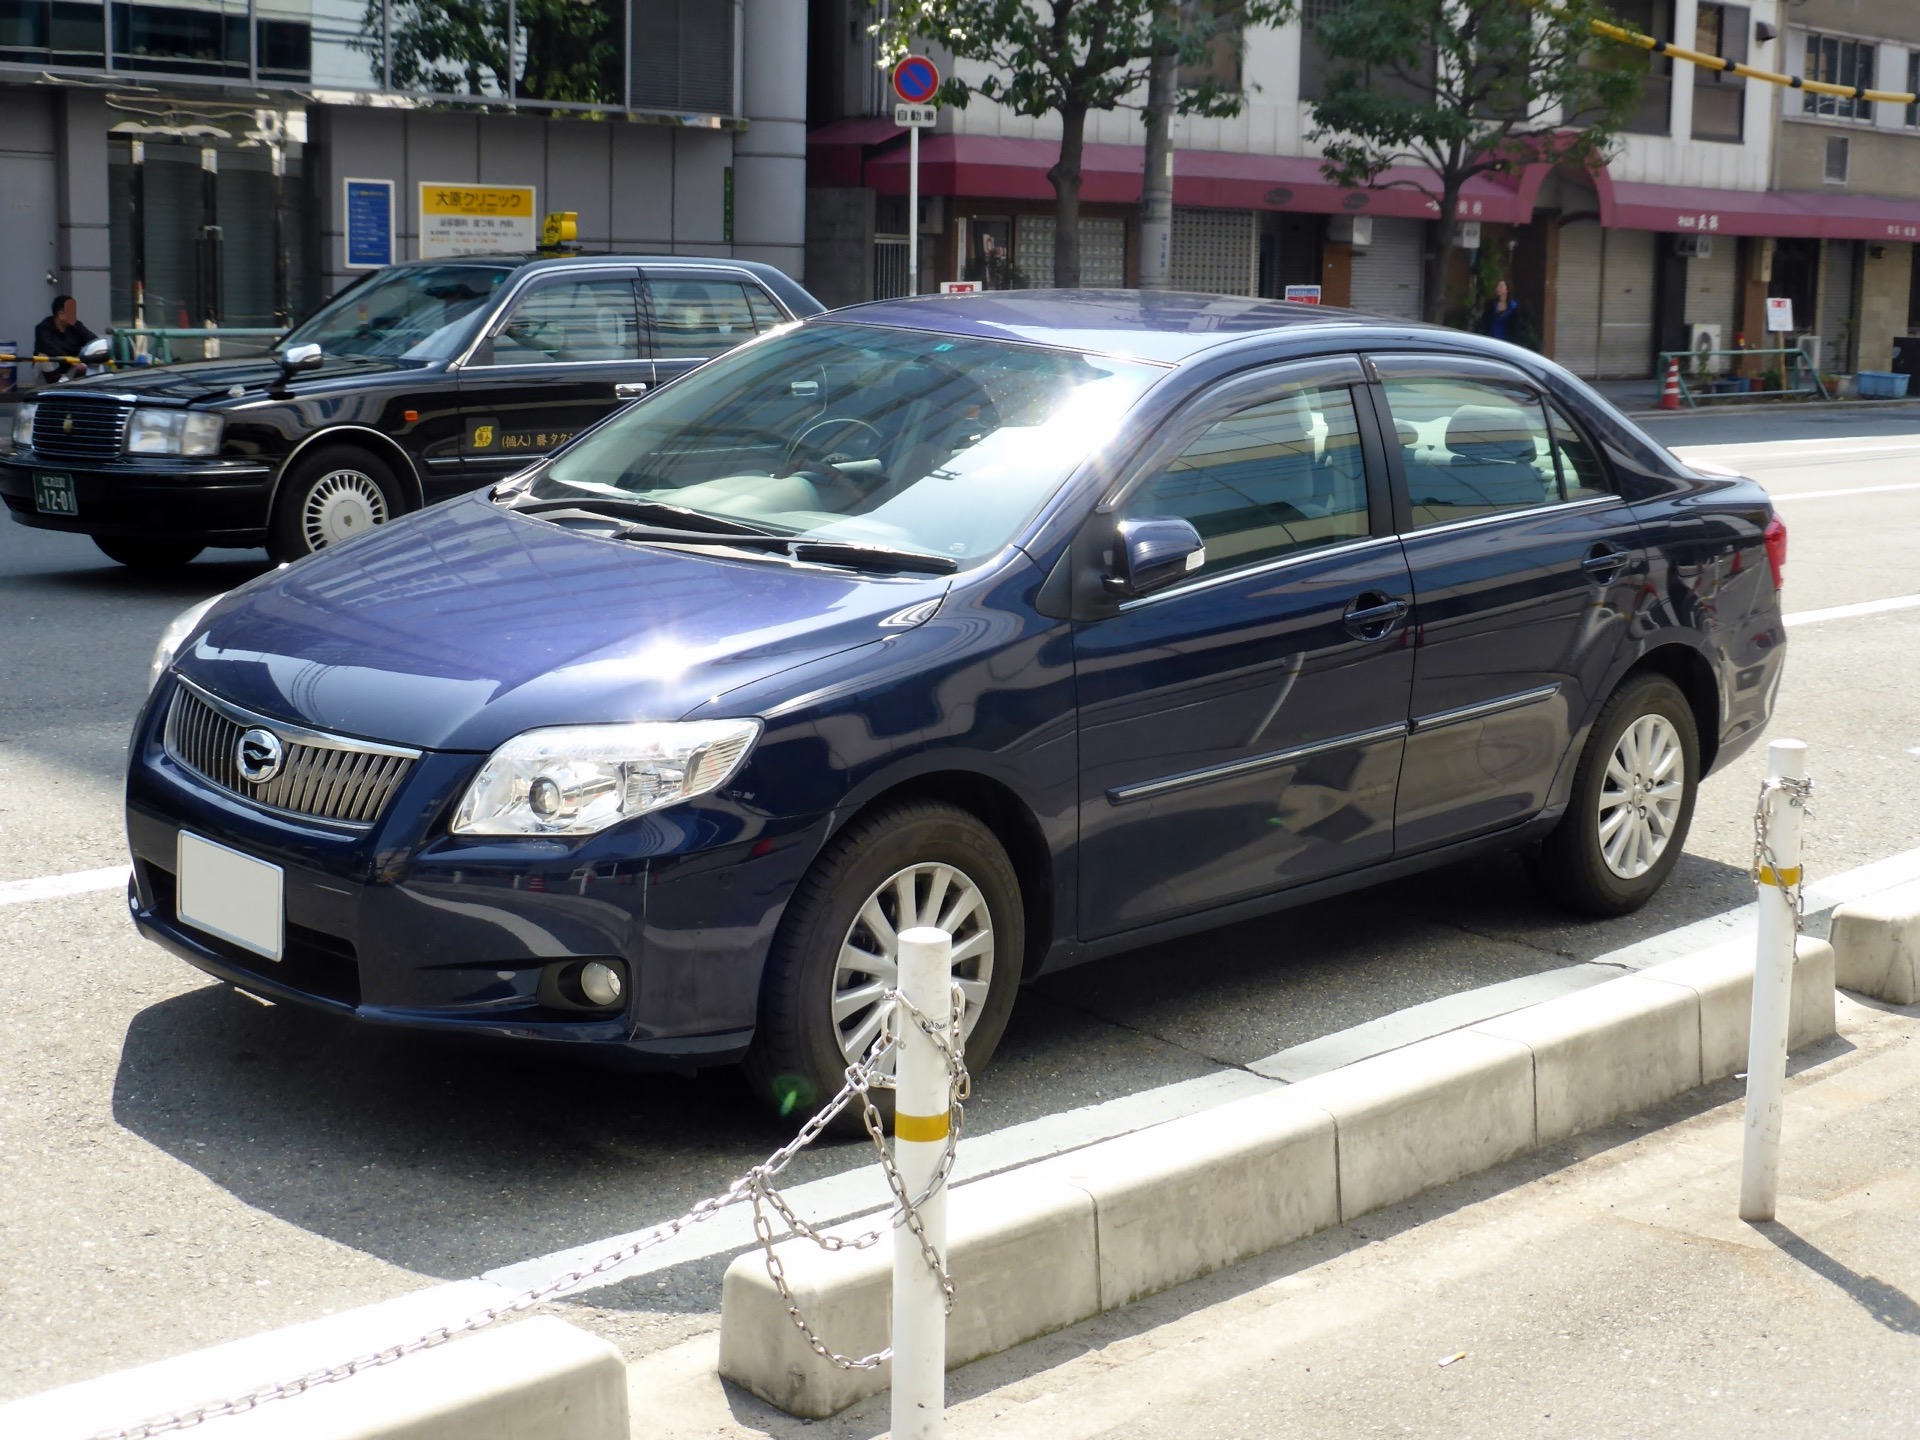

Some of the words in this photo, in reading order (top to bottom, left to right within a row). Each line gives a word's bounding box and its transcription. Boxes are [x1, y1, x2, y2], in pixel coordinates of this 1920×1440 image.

[897, 109, 935, 122] 自動車
[436, 191, 522, 208] 大原クリニック
